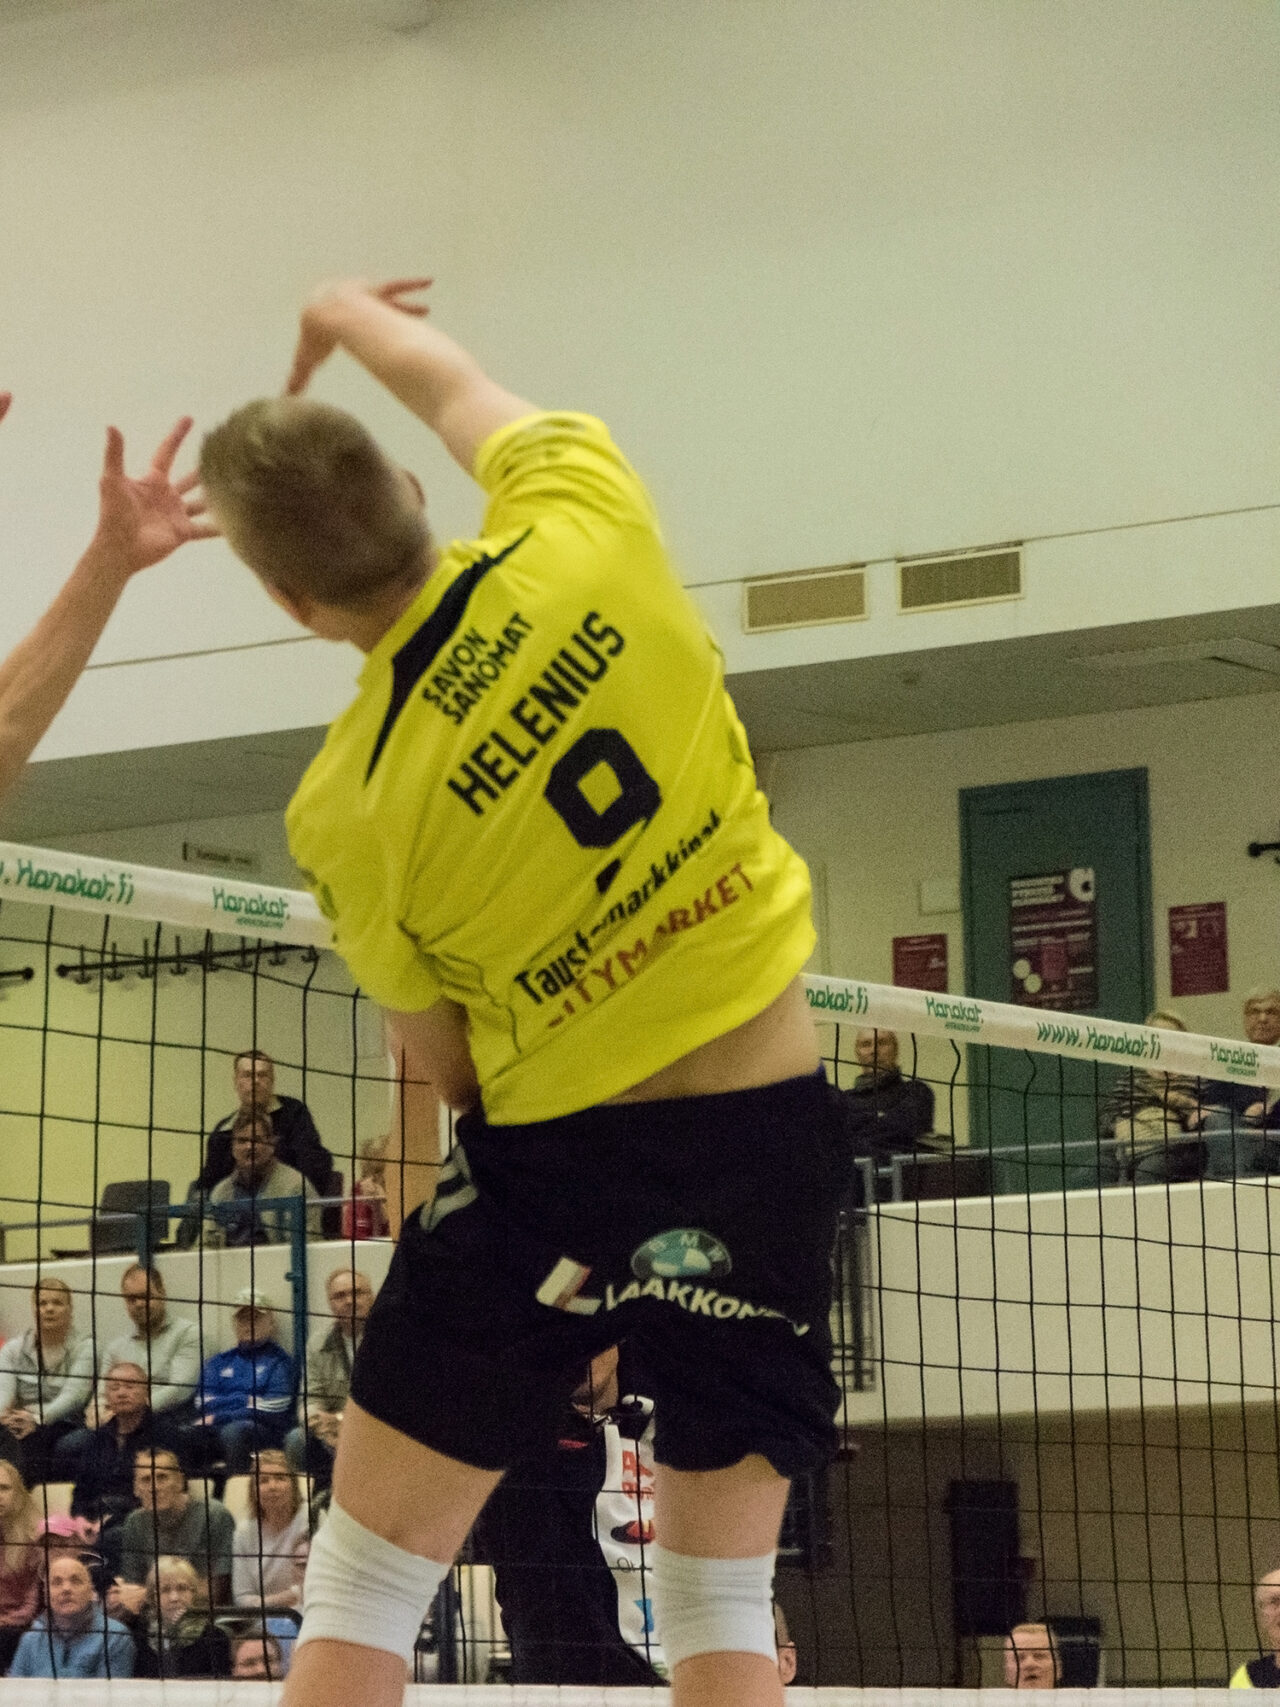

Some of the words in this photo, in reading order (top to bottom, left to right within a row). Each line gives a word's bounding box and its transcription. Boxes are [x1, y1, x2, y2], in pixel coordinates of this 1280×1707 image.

[422, 627, 488, 709] SAVON
[442, 611, 533, 726] SANOMAT
[447, 611, 626, 817] HELENIUS
